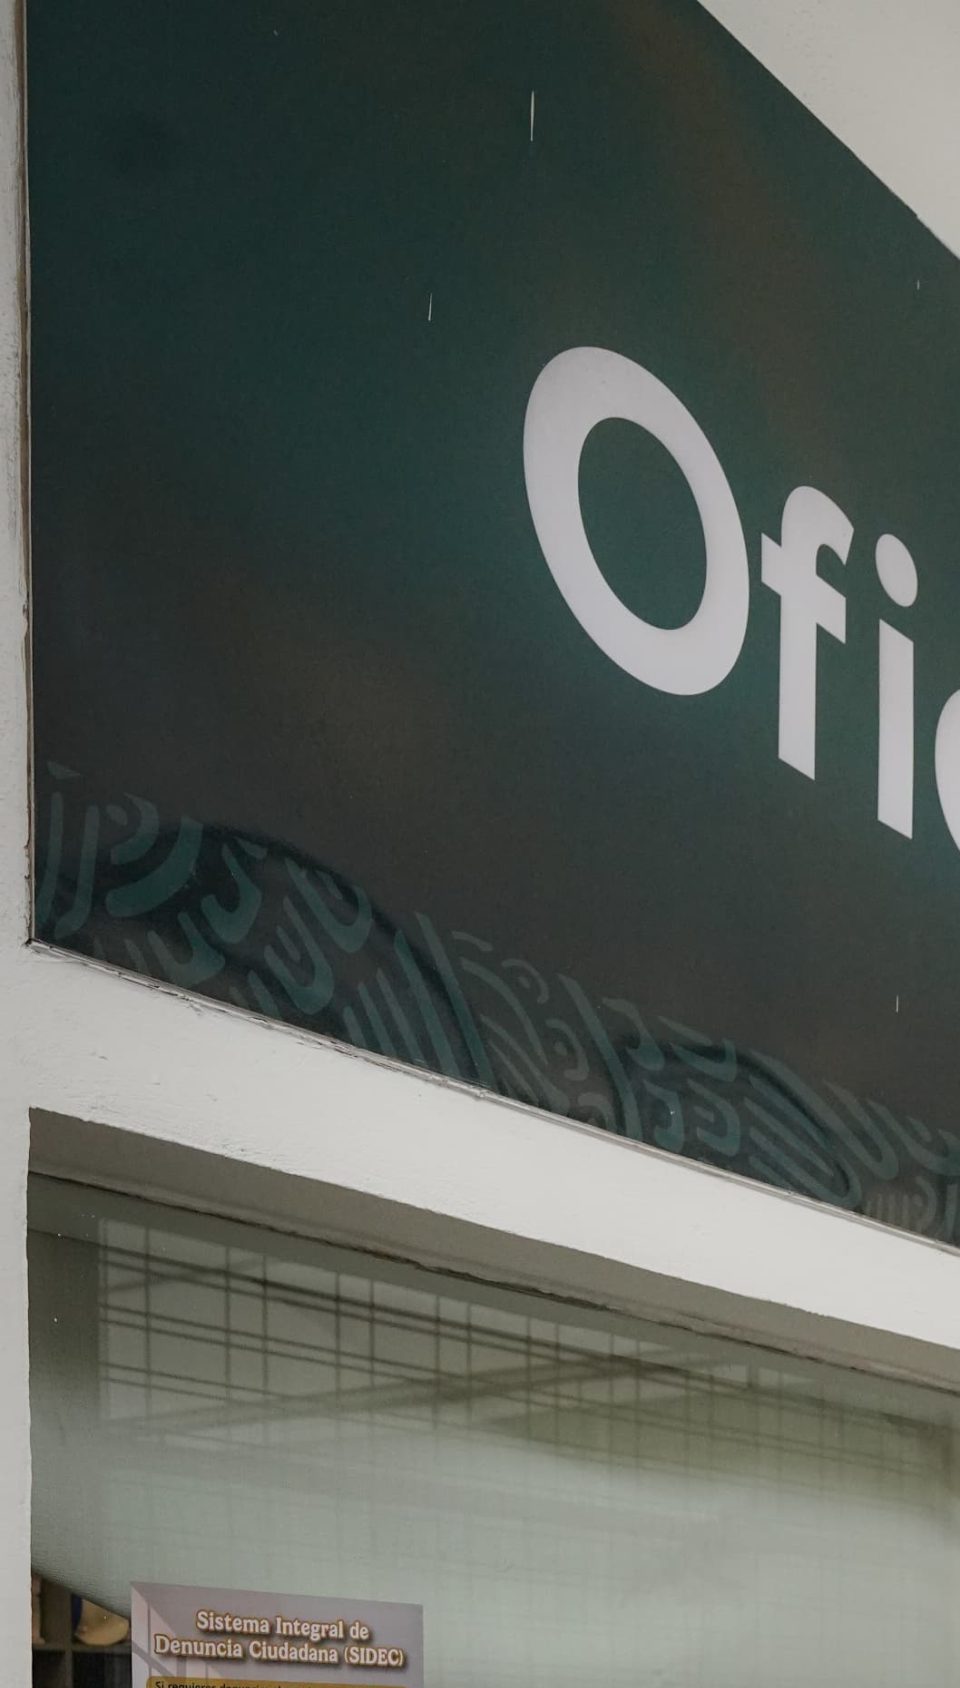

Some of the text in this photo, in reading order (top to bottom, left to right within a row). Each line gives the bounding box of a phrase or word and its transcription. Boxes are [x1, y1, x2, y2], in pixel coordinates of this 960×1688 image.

[197, 1611, 369, 1640] Sistema Integral de
[155, 1635, 404, 1666] Denuncia Ciudadana (SIDEC)
